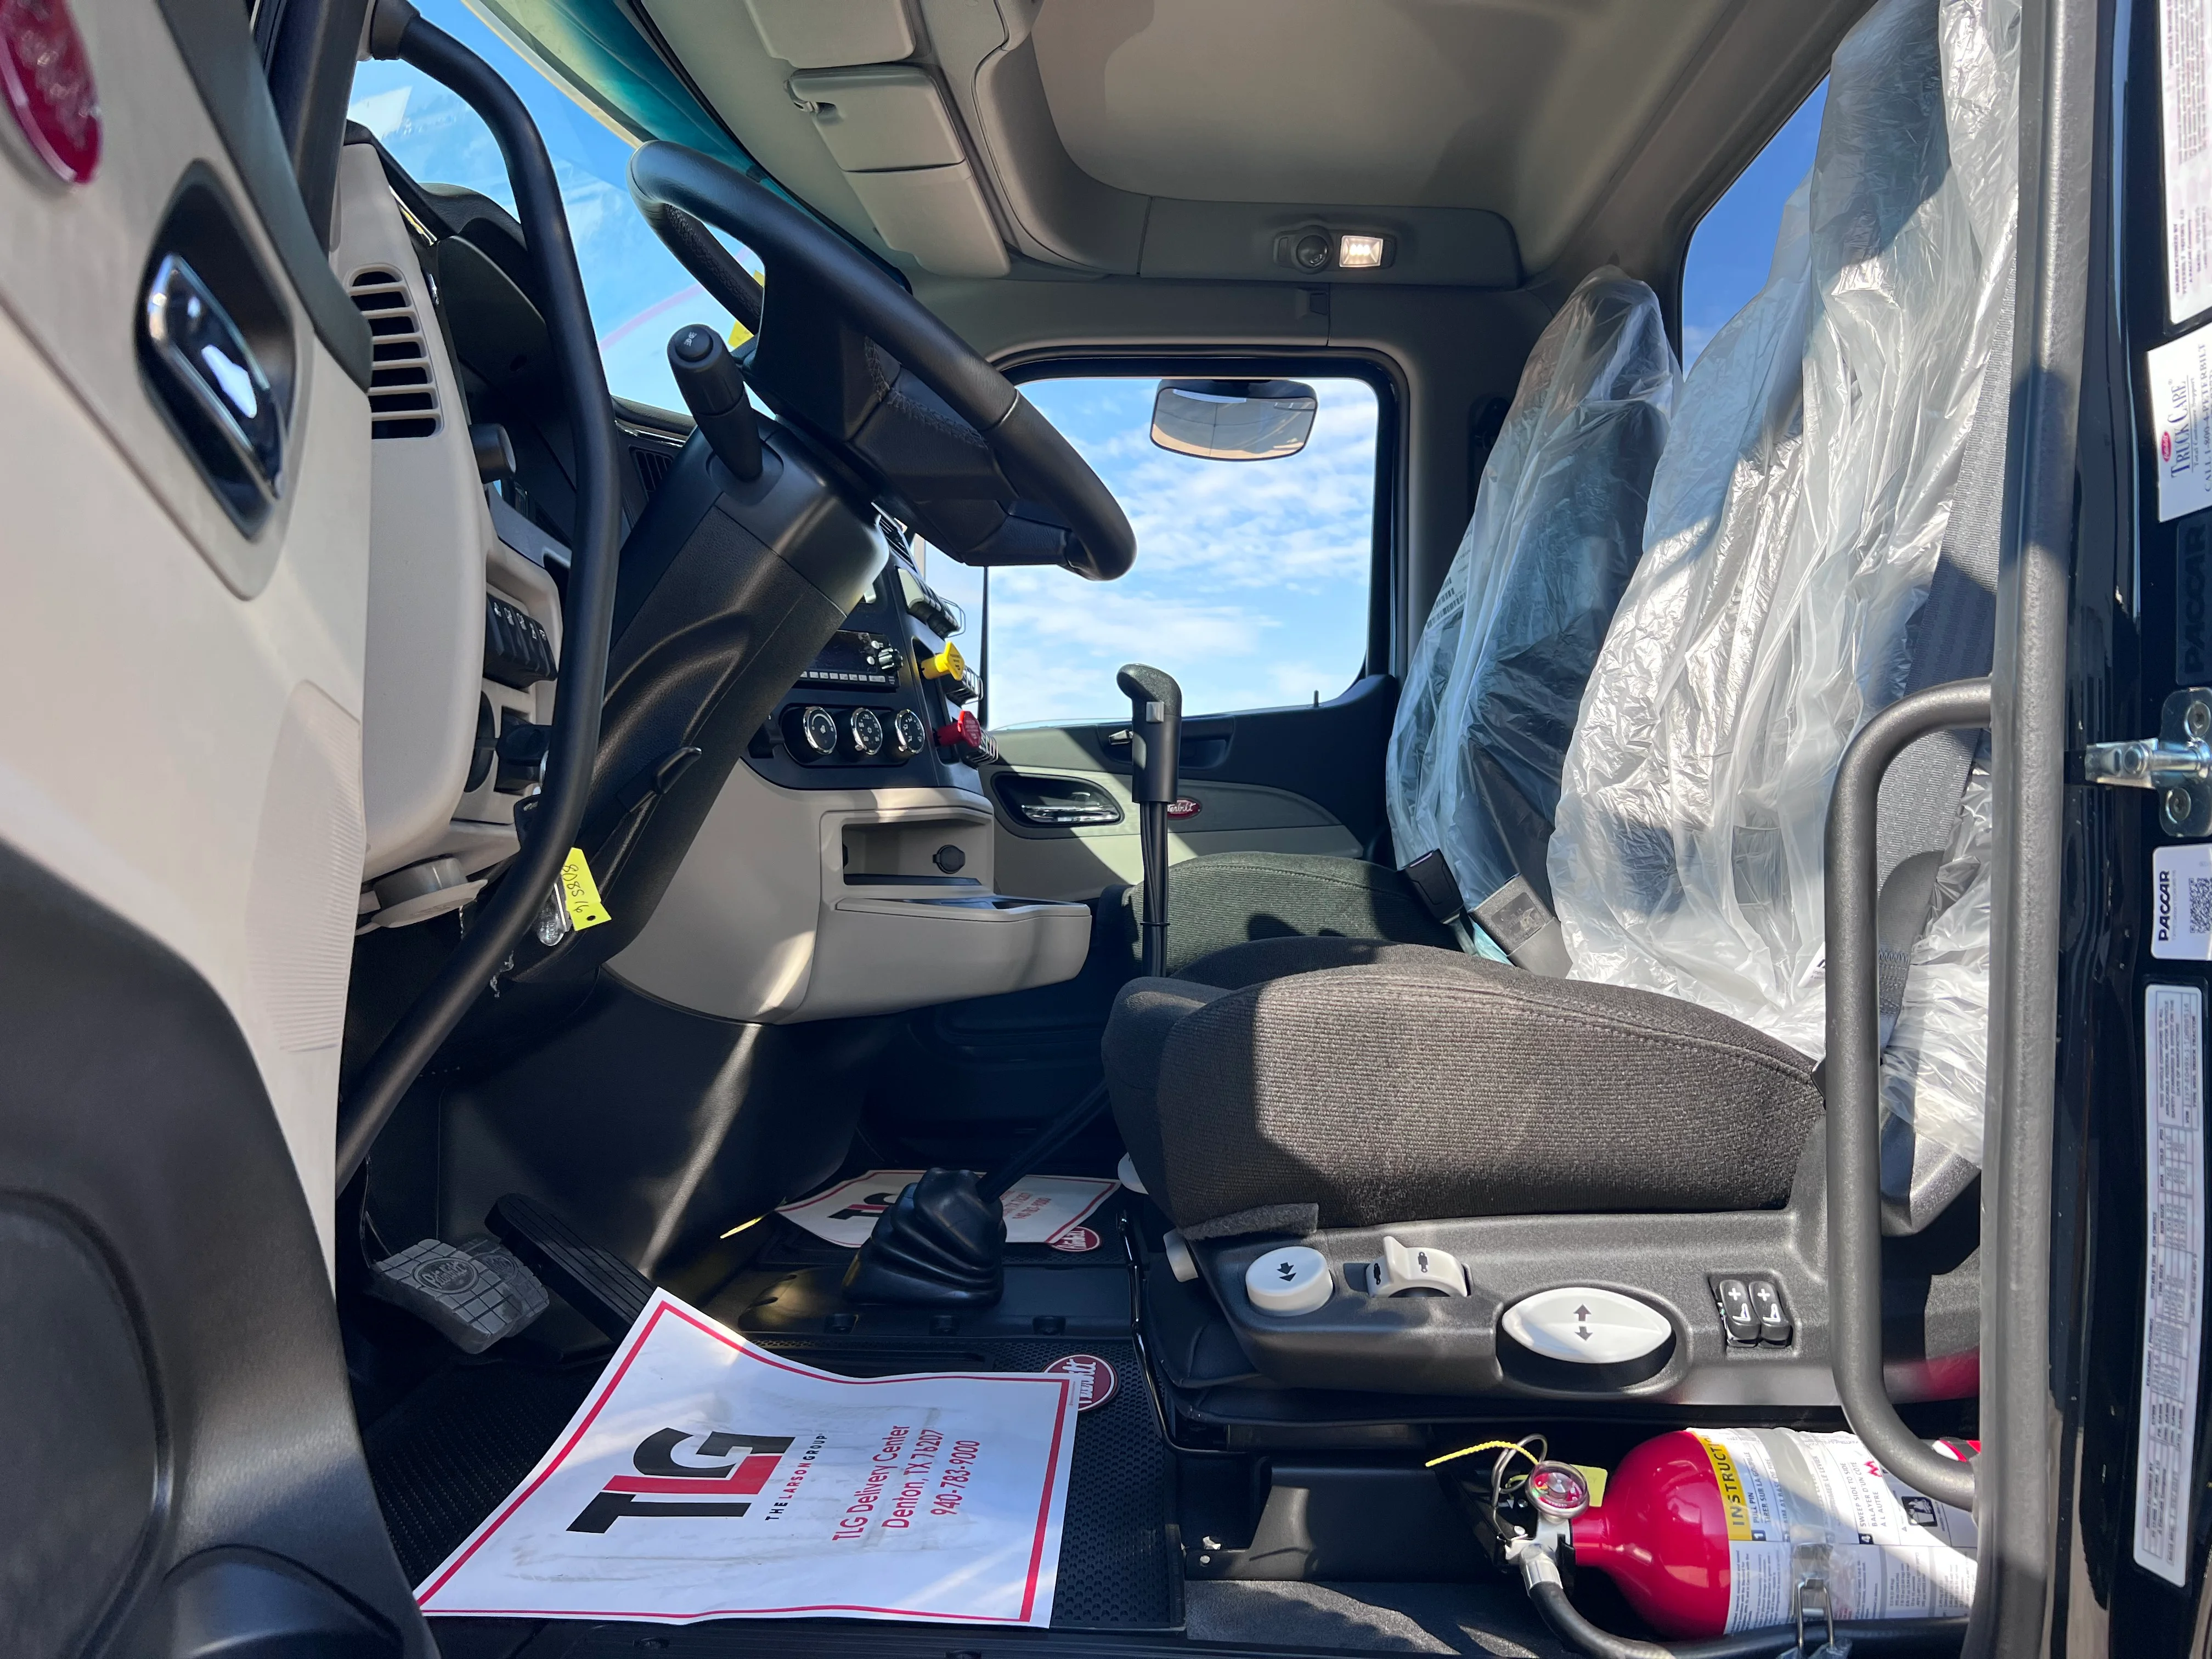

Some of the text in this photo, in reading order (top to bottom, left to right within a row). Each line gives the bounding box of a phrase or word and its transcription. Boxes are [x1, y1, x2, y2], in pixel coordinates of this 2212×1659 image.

[2170, 424, 2190, 478] TRUCK
[2203, 456, 2212, 492] CALL
[2158, 870, 2170, 941] PACCAR
[2159, 1019, 2163, 1028] TO
[2170, 1013, 2174, 1022] ON
[2176, 1070, 2180, 1078] OF
[1744, 1452, 1759, 1477] GOUPILLE
[1765, 1458, 1774, 1469] FIRE
[1770, 1470, 1778, 1479] OF
[1813, 1455, 1826, 1473] LEVIER
[566, 1427, 796, 1534] TLG
[765, 1434, 828, 1521] THE LARSON GROUP
[832, 1425, 910, 1541] TLG Delivery Center
[881, 1429, 944, 1528] Denton, TX 76207
[930, 1440, 980, 1515] 940-783-9000
[1747, 1492, 1756, 1504] PIN
[1758, 1488, 1767, 1501] SUR
[1779, 1499, 1786, 1507] AT
[1840, 1463, 1871, 1543] 4 SWEEP SIDE TO SIDE
[1849, 1462, 1878, 1527] BALAYER D'UN CÔTÉ
[1751, 1506, 1759, 1523] PULL
[1762, 1504, 1771, 1523] TIRER
